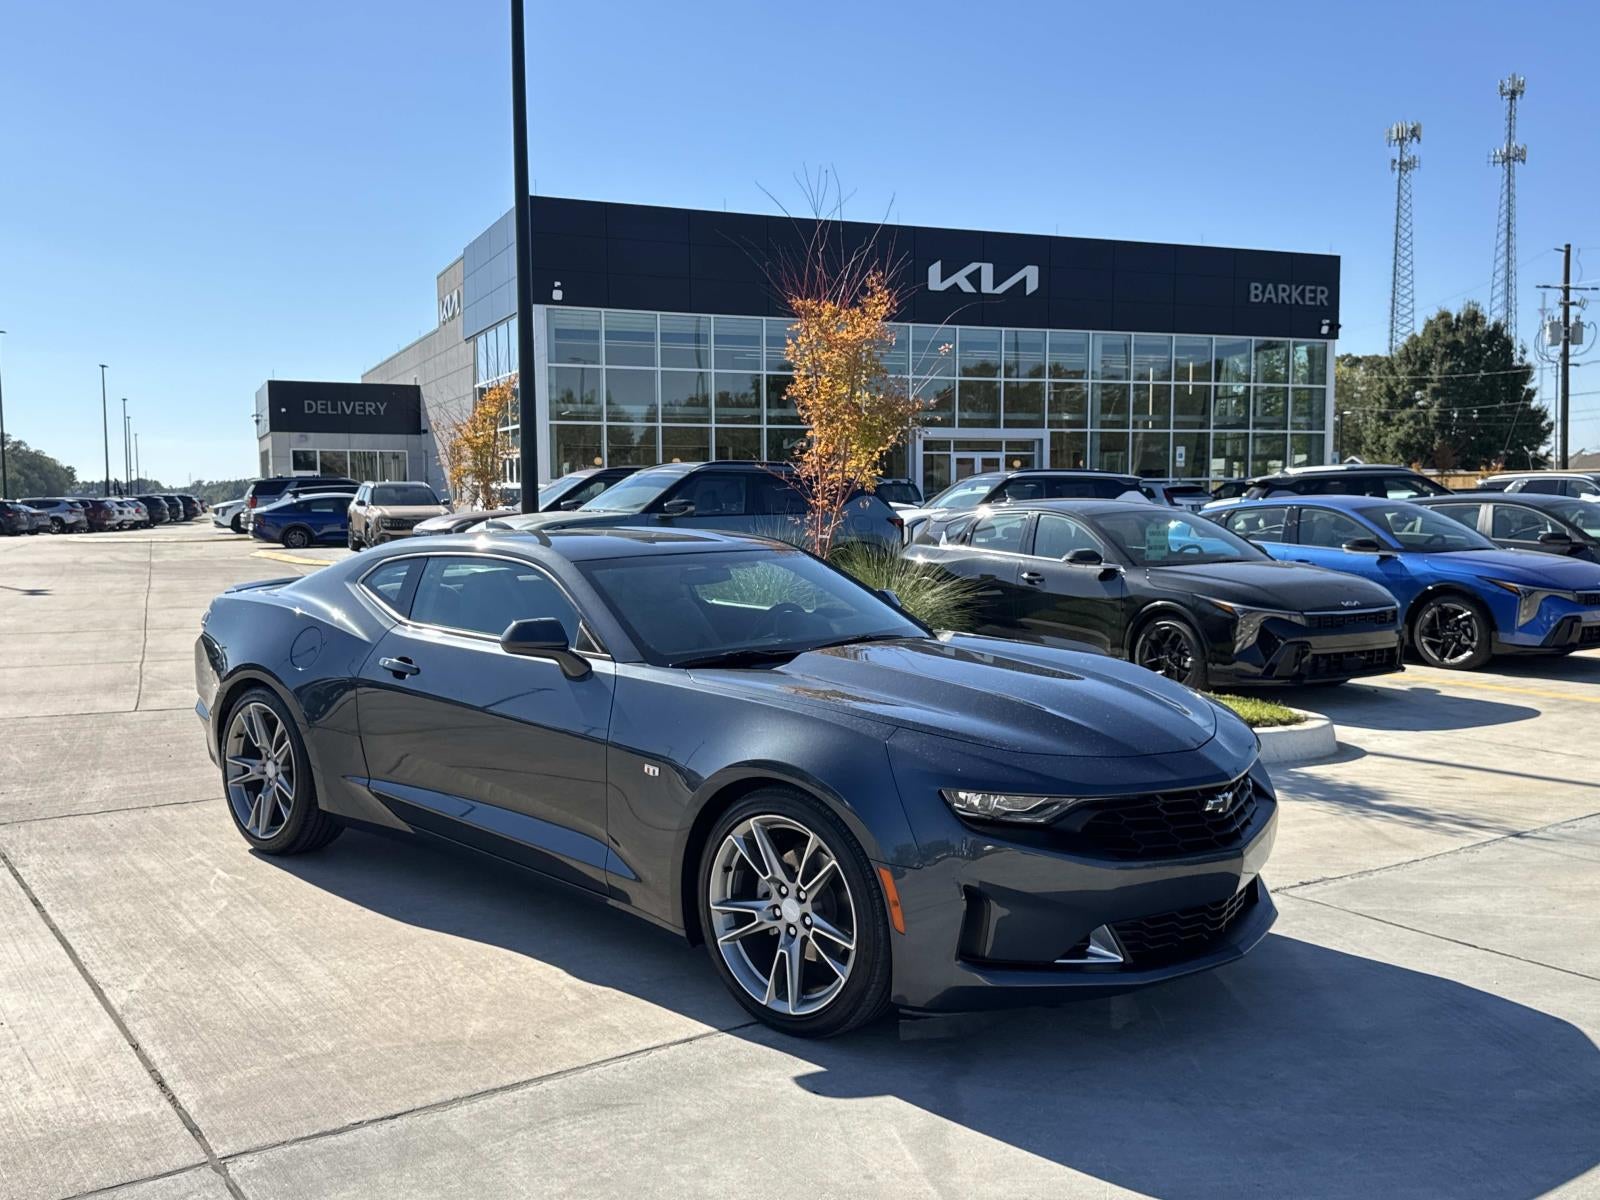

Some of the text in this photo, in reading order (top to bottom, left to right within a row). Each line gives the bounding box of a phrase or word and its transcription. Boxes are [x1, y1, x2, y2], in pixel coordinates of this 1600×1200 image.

[928, 259, 1039, 296] KIA
[1249, 281, 1329, 307] BARKER
[303, 399, 388, 416] DELIVERY
